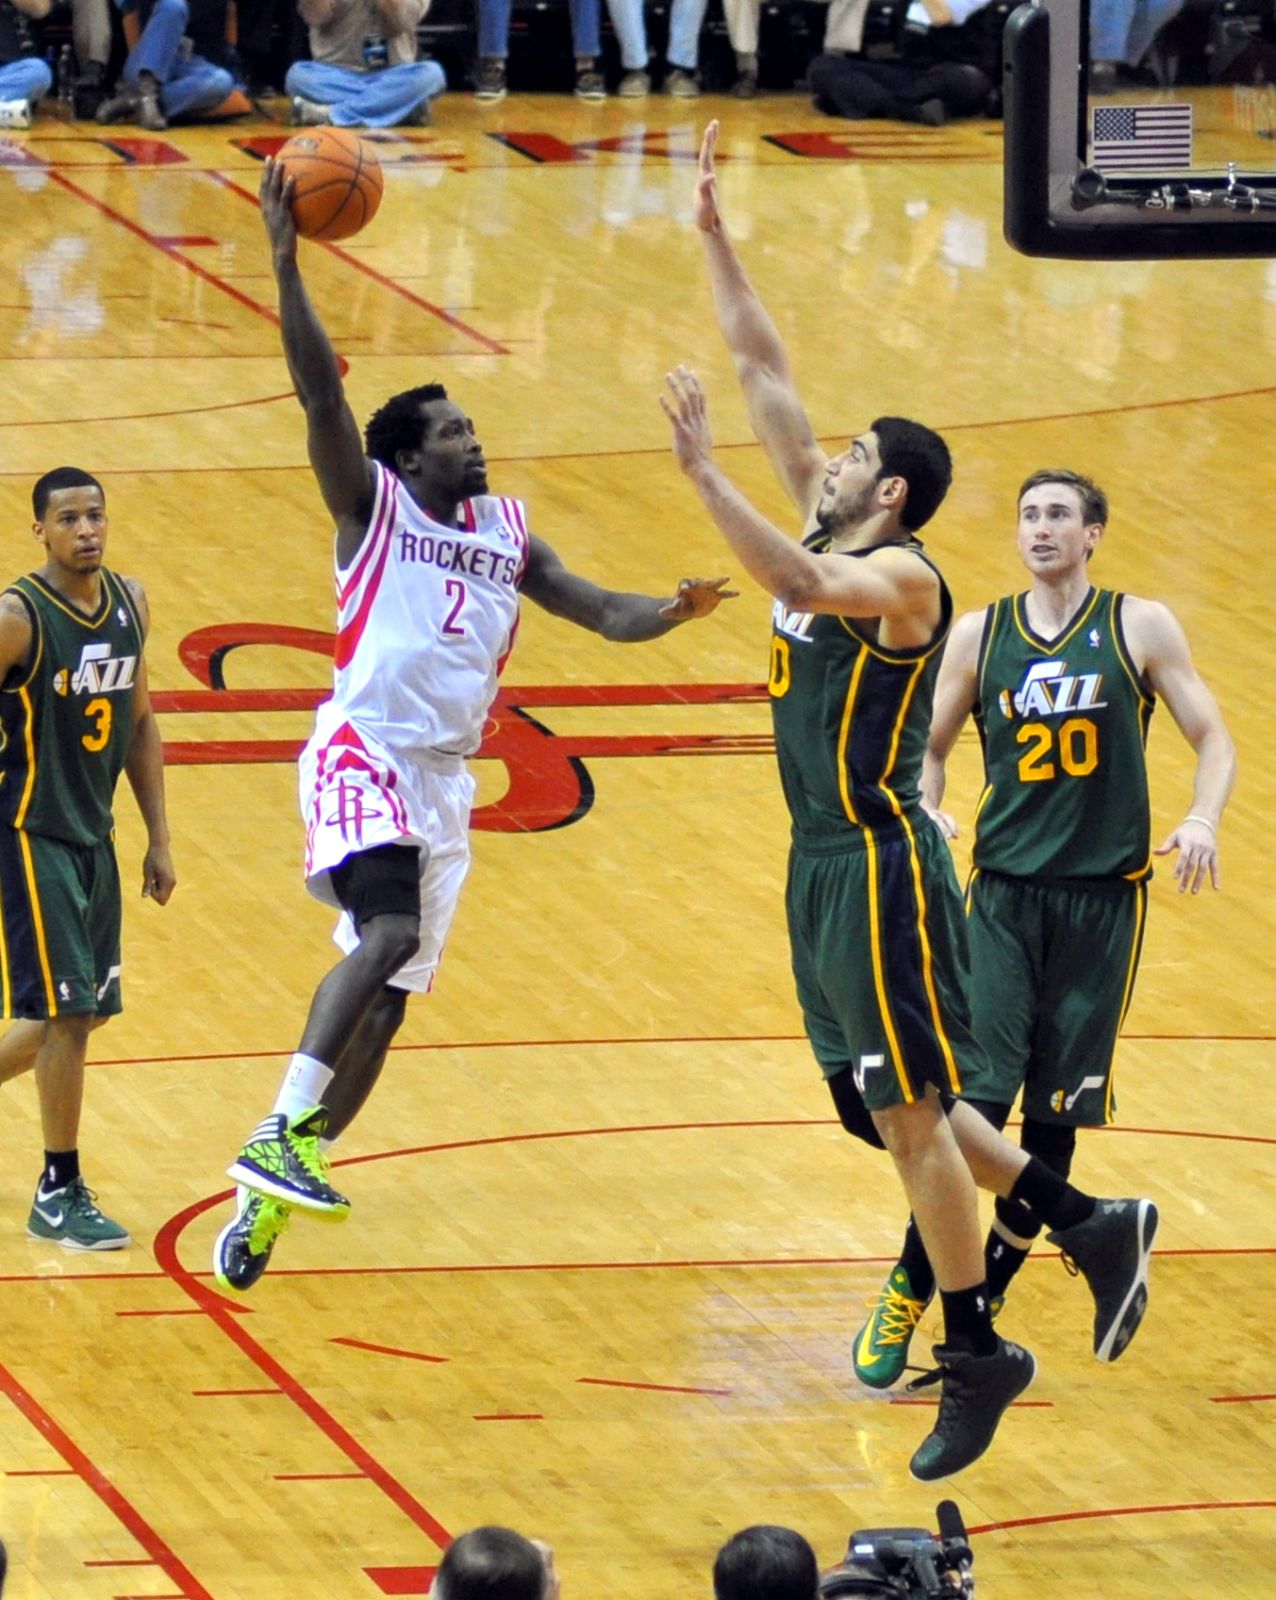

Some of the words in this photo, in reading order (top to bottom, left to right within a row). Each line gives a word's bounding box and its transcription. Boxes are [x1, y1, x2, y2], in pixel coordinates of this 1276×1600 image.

[398, 529, 516, 585] ROCKETS
[442, 579, 466, 636] 2
[81, 698, 112, 752] 3
[1016, 718, 1099, 782] 20
